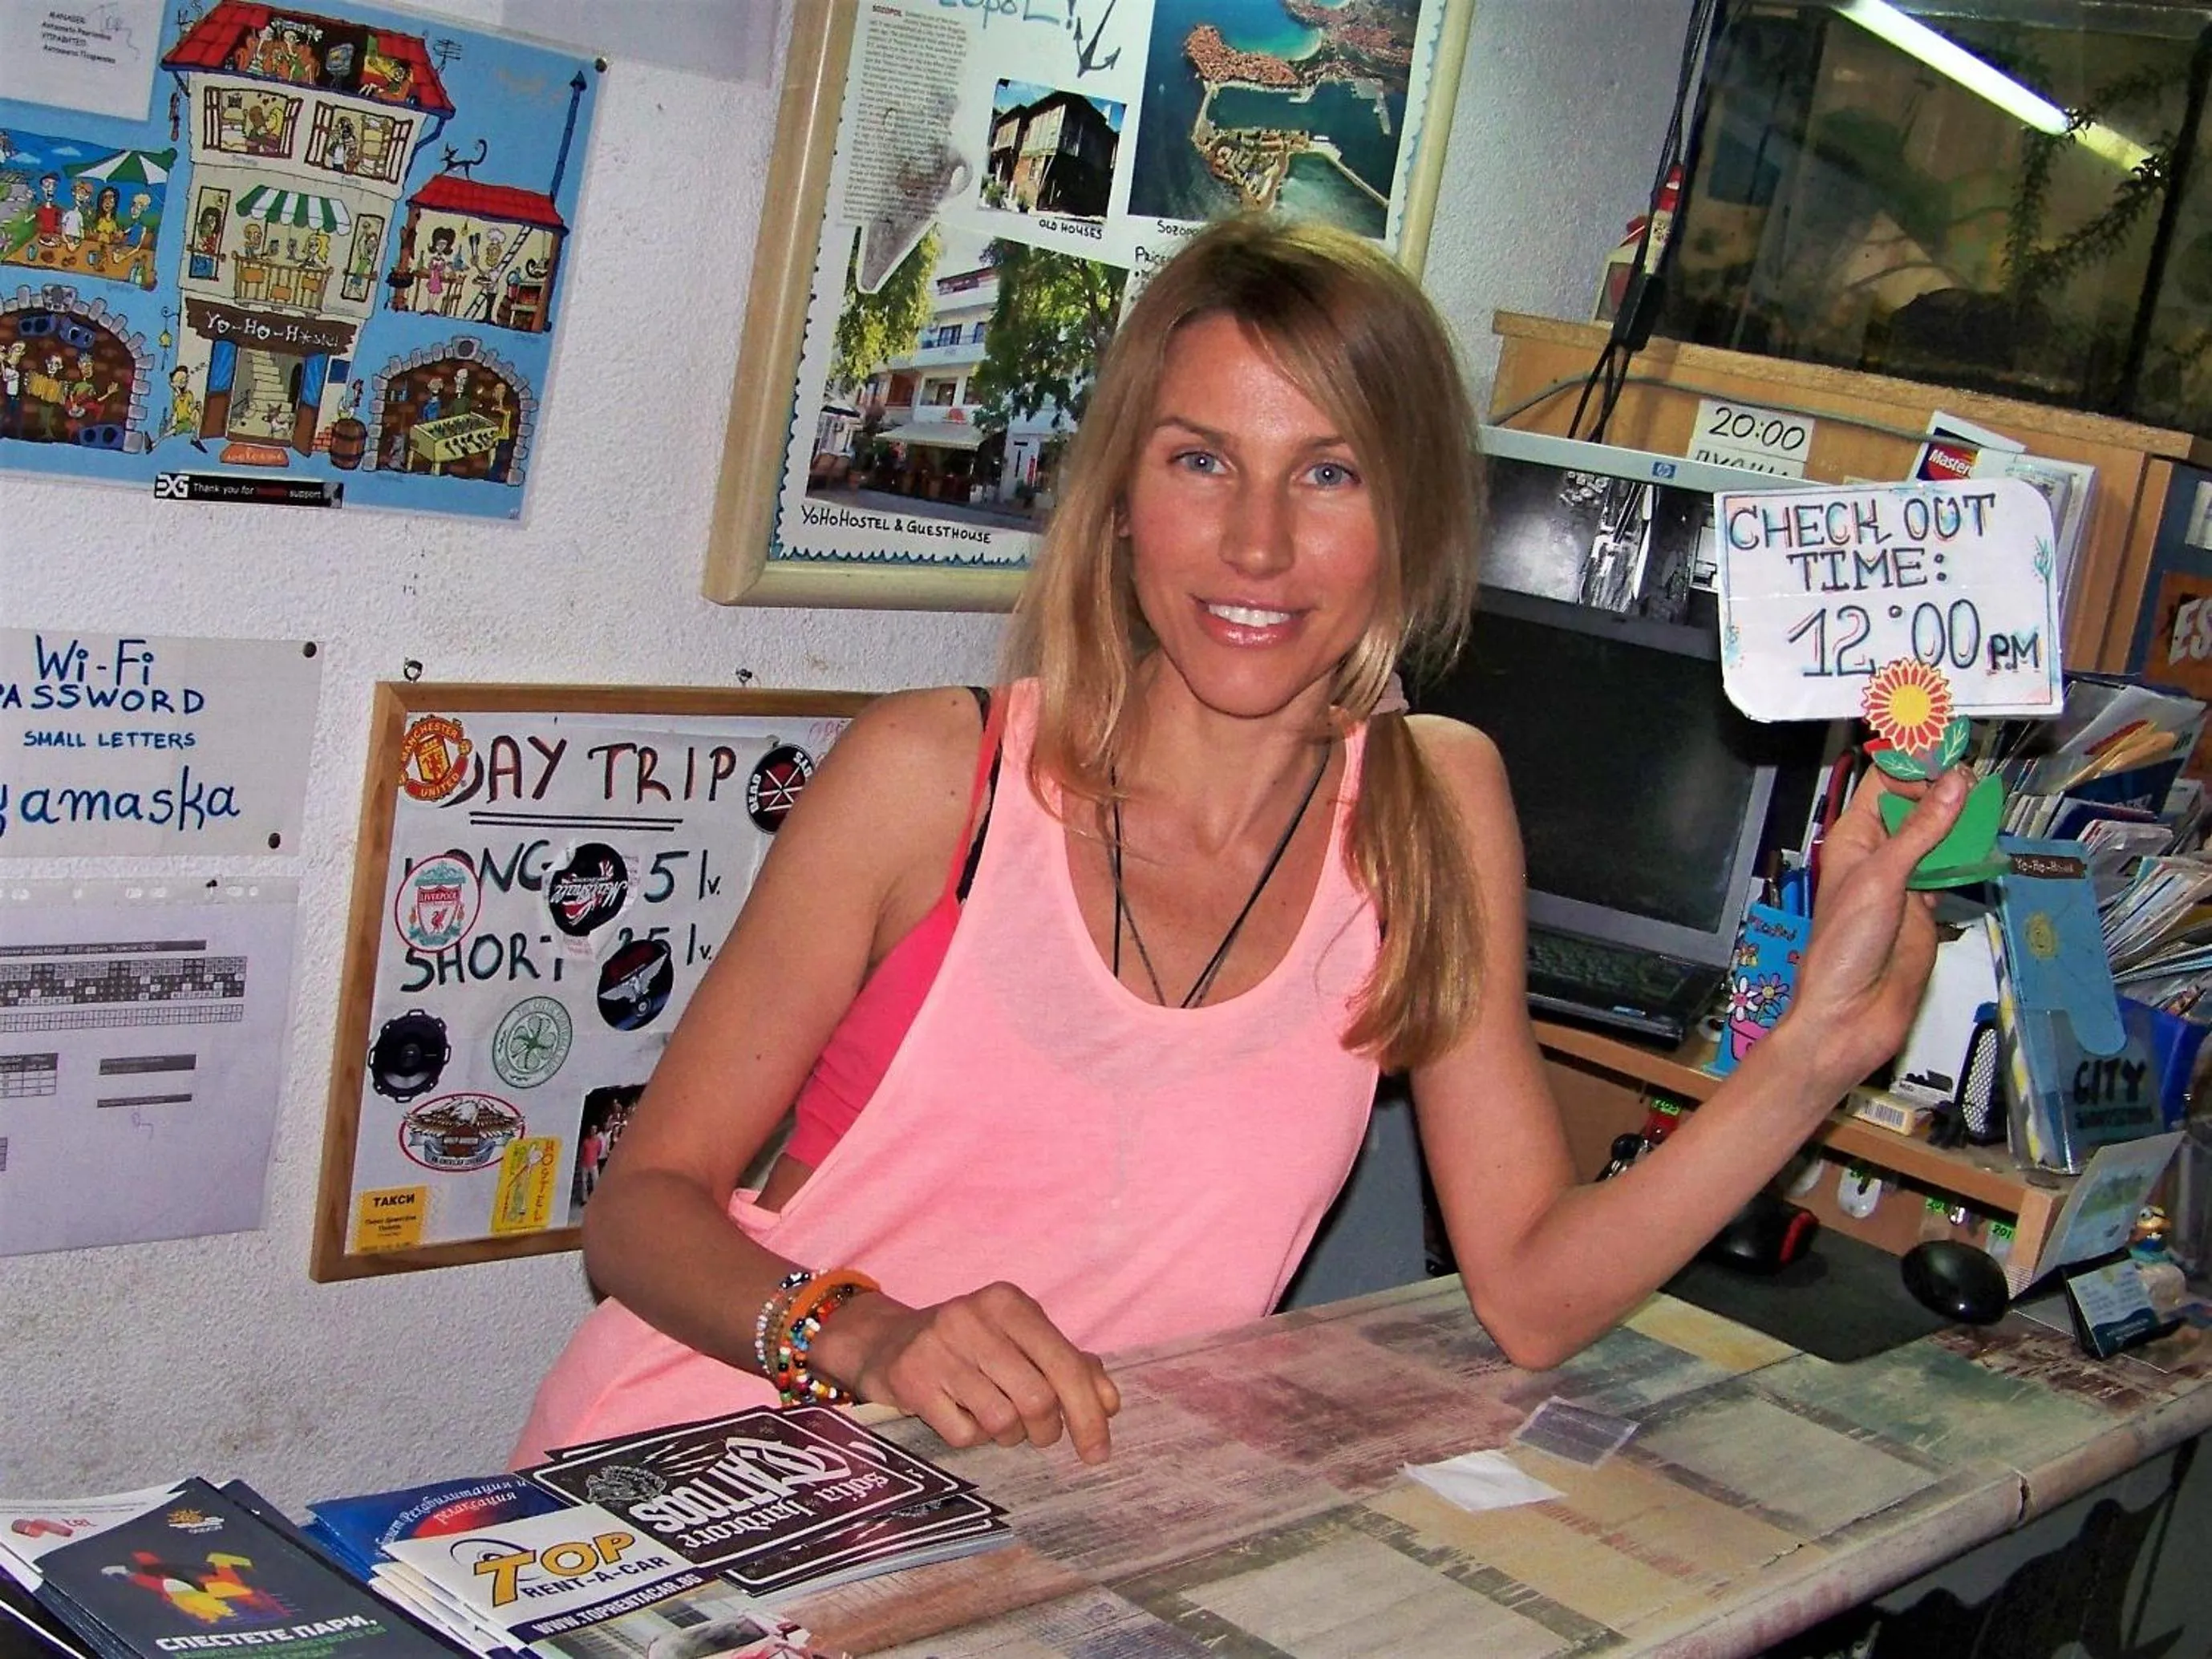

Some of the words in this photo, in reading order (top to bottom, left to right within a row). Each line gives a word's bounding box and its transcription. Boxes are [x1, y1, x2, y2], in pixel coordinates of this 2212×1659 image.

[1039, 219, 1057, 231] OLD
[1061, 224, 1103, 240] HOUSES
[1708, 407, 1805, 451] 20:00
[193, 484, 220, 495] Thank
[223, 485, 239, 496] you
[241, 484, 255, 496] for
[290, 488, 322, 500] support
[894, 518, 904, 532] &
[1729, 498, 1893, 551] CHECK
[1903, 492, 1996, 541] OUT
[1787, 547, 1948, 593] TIME:
[1788, 598, 1981, 678] 12:00
[36, 634, 155, 686] Wi-Fi
[23, 730, 87, 748] SMALL
[98, 731, 196, 750] LETTERS
[401, 722, 460, 763] MANCHESTER
[420, 771, 460, 797] UNITED
[587, 742, 737, 805] TRIP
[2073, 1058, 2147, 1105] CITY
[373, 1192, 415, 1208] ТАКСИ
[473, 1532, 636, 1608] TOP
[520, 1556, 673, 1598] RENT-A-CAR
[530, 1573, 704, 1636] WWW.TOPRENTACAR.BG
[156, 1627, 295, 1652] СПЕСТЕТЕ
[290, 1614, 379, 1639] ПАРИ,
